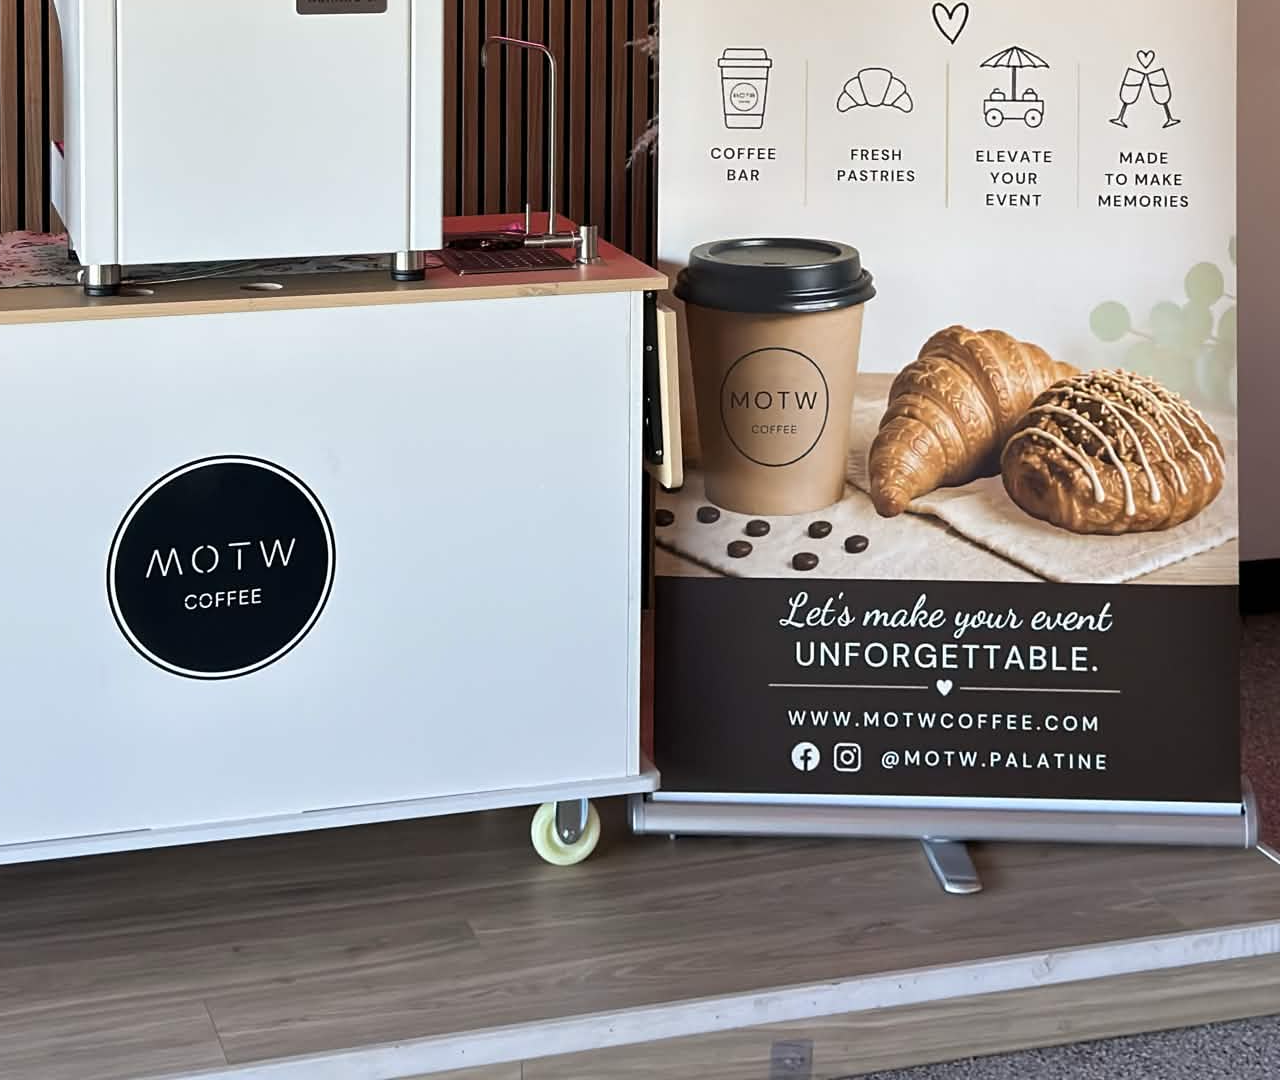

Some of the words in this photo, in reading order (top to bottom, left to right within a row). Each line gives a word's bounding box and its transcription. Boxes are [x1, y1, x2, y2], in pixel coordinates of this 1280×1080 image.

[710, 147, 776, 160] COFFEE
[850, 148, 902, 161] FRESH
[975, 150, 1052, 163] ELEVATE
[1119, 151, 1168, 165] MADE
[727, 168, 760, 182] BAR
[837, 169, 915, 182] PASTRIES
[990, 171, 1038, 185] YOUR
[1104, 173, 1128, 186] TO
[1135, 173, 1182, 186] MAKE
[986, 193, 1042, 206] EVENT
[1098, 194, 1189, 208] MEMORIES
[730, 390, 818, 410] MOTW
[750, 423, 798, 434] COFFEE
[145, 537, 296, 579] MOTW
[184, 588, 262, 610] COFFEE
[778, 591, 856, 628] Let's
[862, 593, 947, 629] make
[953, 608, 1024, 639] your
[1030, 602, 1113, 632] event
[796, 641, 1098, 672] UNFORGETTABLE.
[788, 710, 1098, 732] WWW.MOTWCOFFEE.COM
[881, 750, 1107, 770] @MOTW.PALATINE
